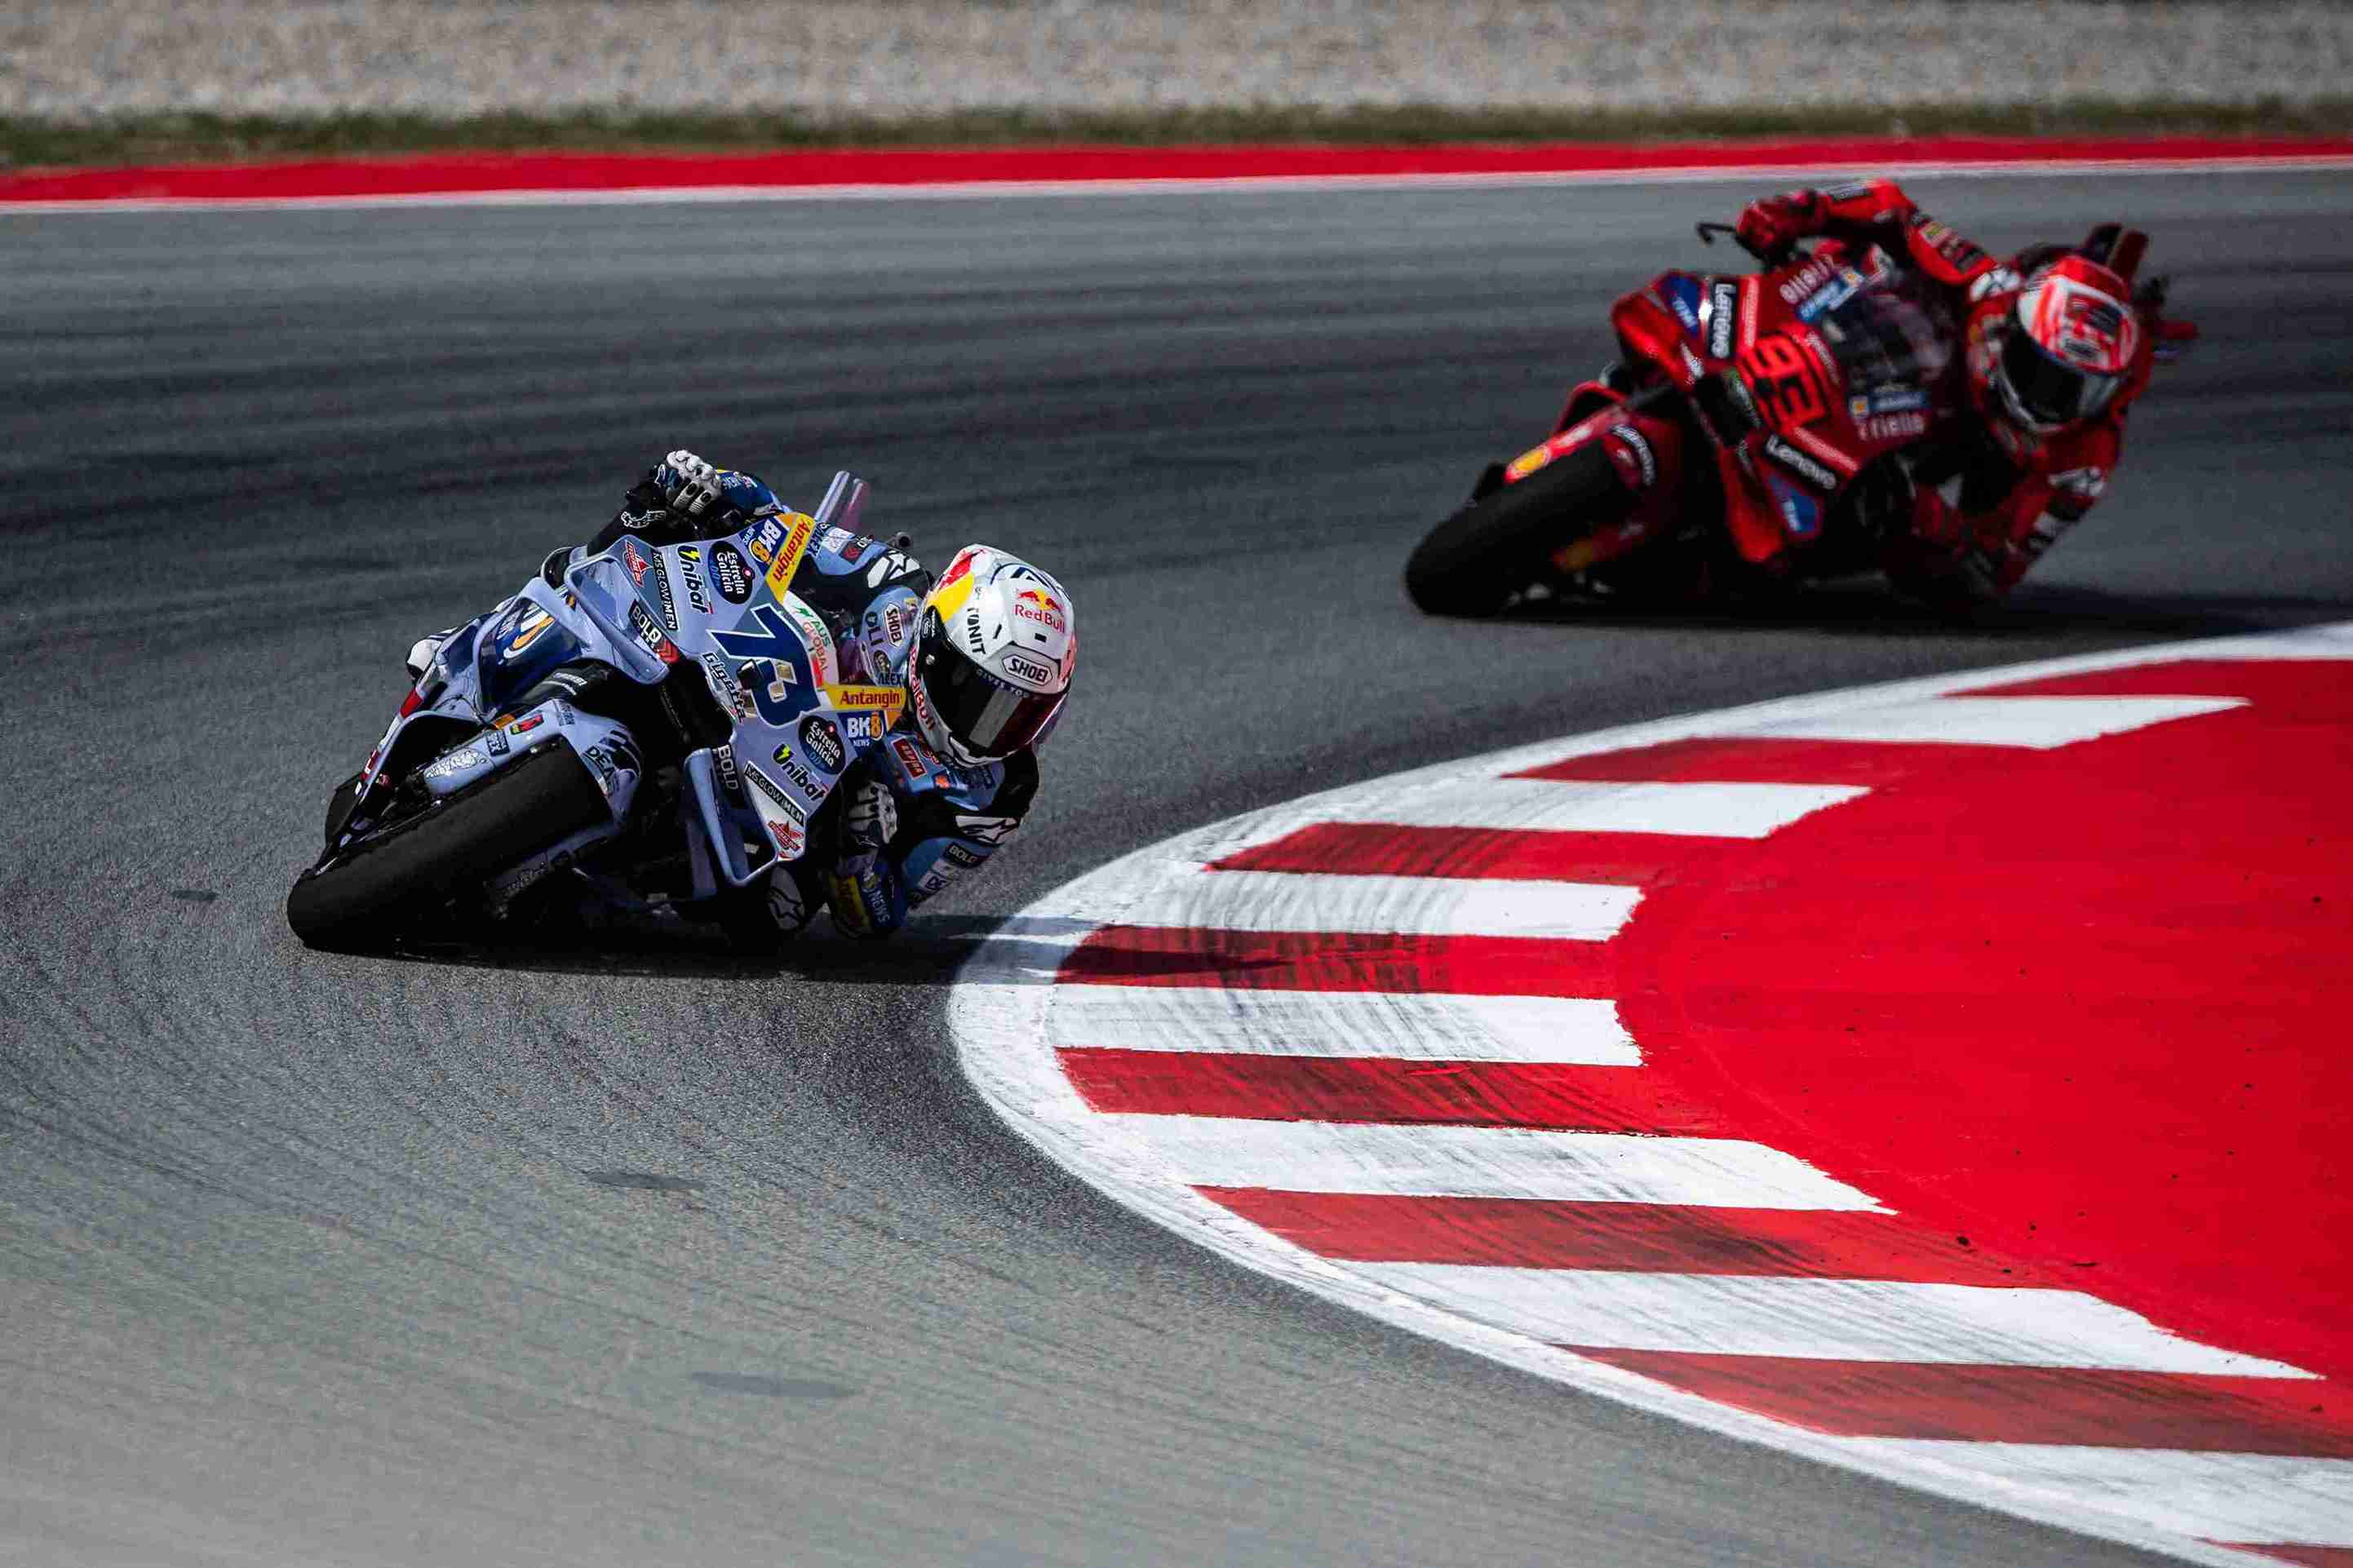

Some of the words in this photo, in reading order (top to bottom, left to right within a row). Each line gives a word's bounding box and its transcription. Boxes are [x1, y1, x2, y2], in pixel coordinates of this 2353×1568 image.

[1710, 283, 1737, 358] Lenovo
[1751, 334, 1828, 426] 93
[1766, 434, 1837, 489] Lenovo
[743, 527, 756, 547] NEWS
[750, 519, 782, 565] BK8
[773, 520, 810, 582] Antangin
[653, 552, 663, 569] MS
[677, 546, 709, 613] Unibat
[716, 552, 733, 592] Galicia
[728, 552, 744, 595] Estrella
[656, 569, 671, 603] GLOW
[663, 605, 678, 630] MEN
[814, 619, 831, 647] AUS
[1015, 604, 1043, 621] Red
[1043, 613, 1066, 633] Bull
[707, 603, 821, 728] 73
[803, 621, 827, 673] GLOBAL
[1009, 655, 1048, 684] SHOEI
[840, 691, 901, 708] Antangin
[810, 721, 841, 758] Estrella
[847, 711, 884, 741] BK8
[853, 739, 871, 748] NEWS
[718, 745, 738, 790] BOLD
[806, 732, 835, 768] Galicia
[773, 743, 826, 801] Unibat
[746, 764, 760, 779] MS
[756, 775, 783, 804] GLOW
[782, 800, 804, 826] MEN
[867, 888, 891, 923] NEWS
